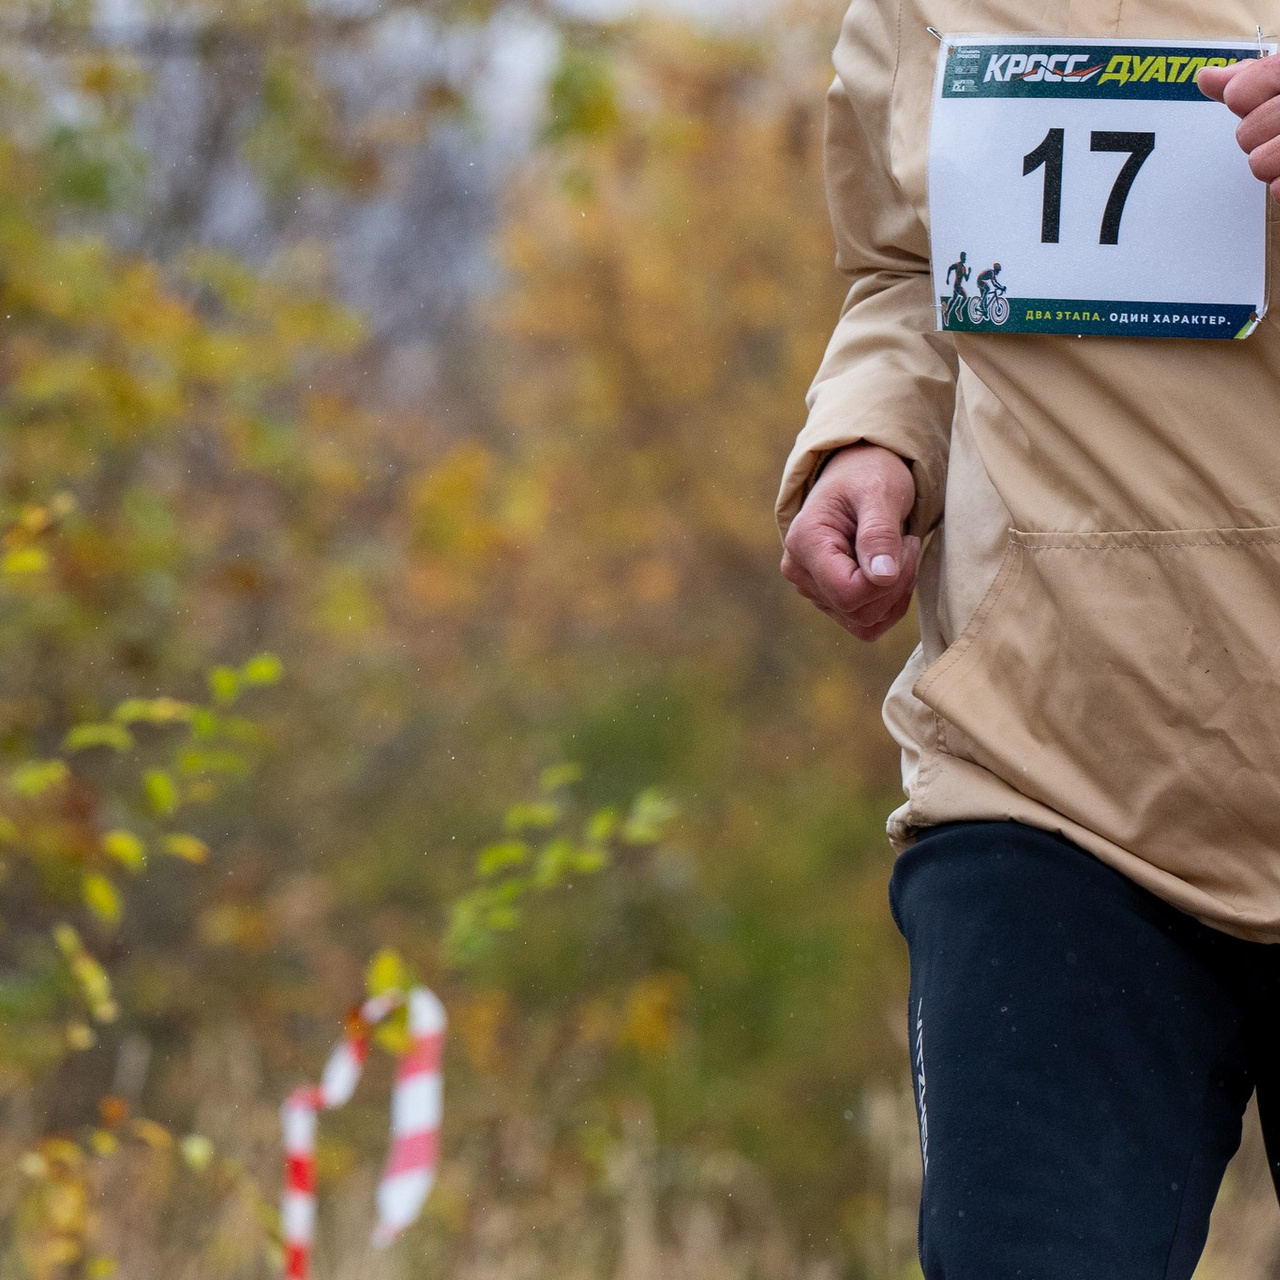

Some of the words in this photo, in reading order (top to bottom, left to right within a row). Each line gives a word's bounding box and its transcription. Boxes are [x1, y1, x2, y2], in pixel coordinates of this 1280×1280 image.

[984, 54, 1101, 82] КРОСС
[1098, 56, 1238, 86] ДУАТЛ
[1022, 127, 1155, 245] 17
[1026, 310, 1052, 320] ДВА
[1056, 311, 1105, 321] ЭТАПА.
[1109, 312, 1149, 324] ОДИН
[1152, 313, 1231, 325] ХАРАКТЕР.
